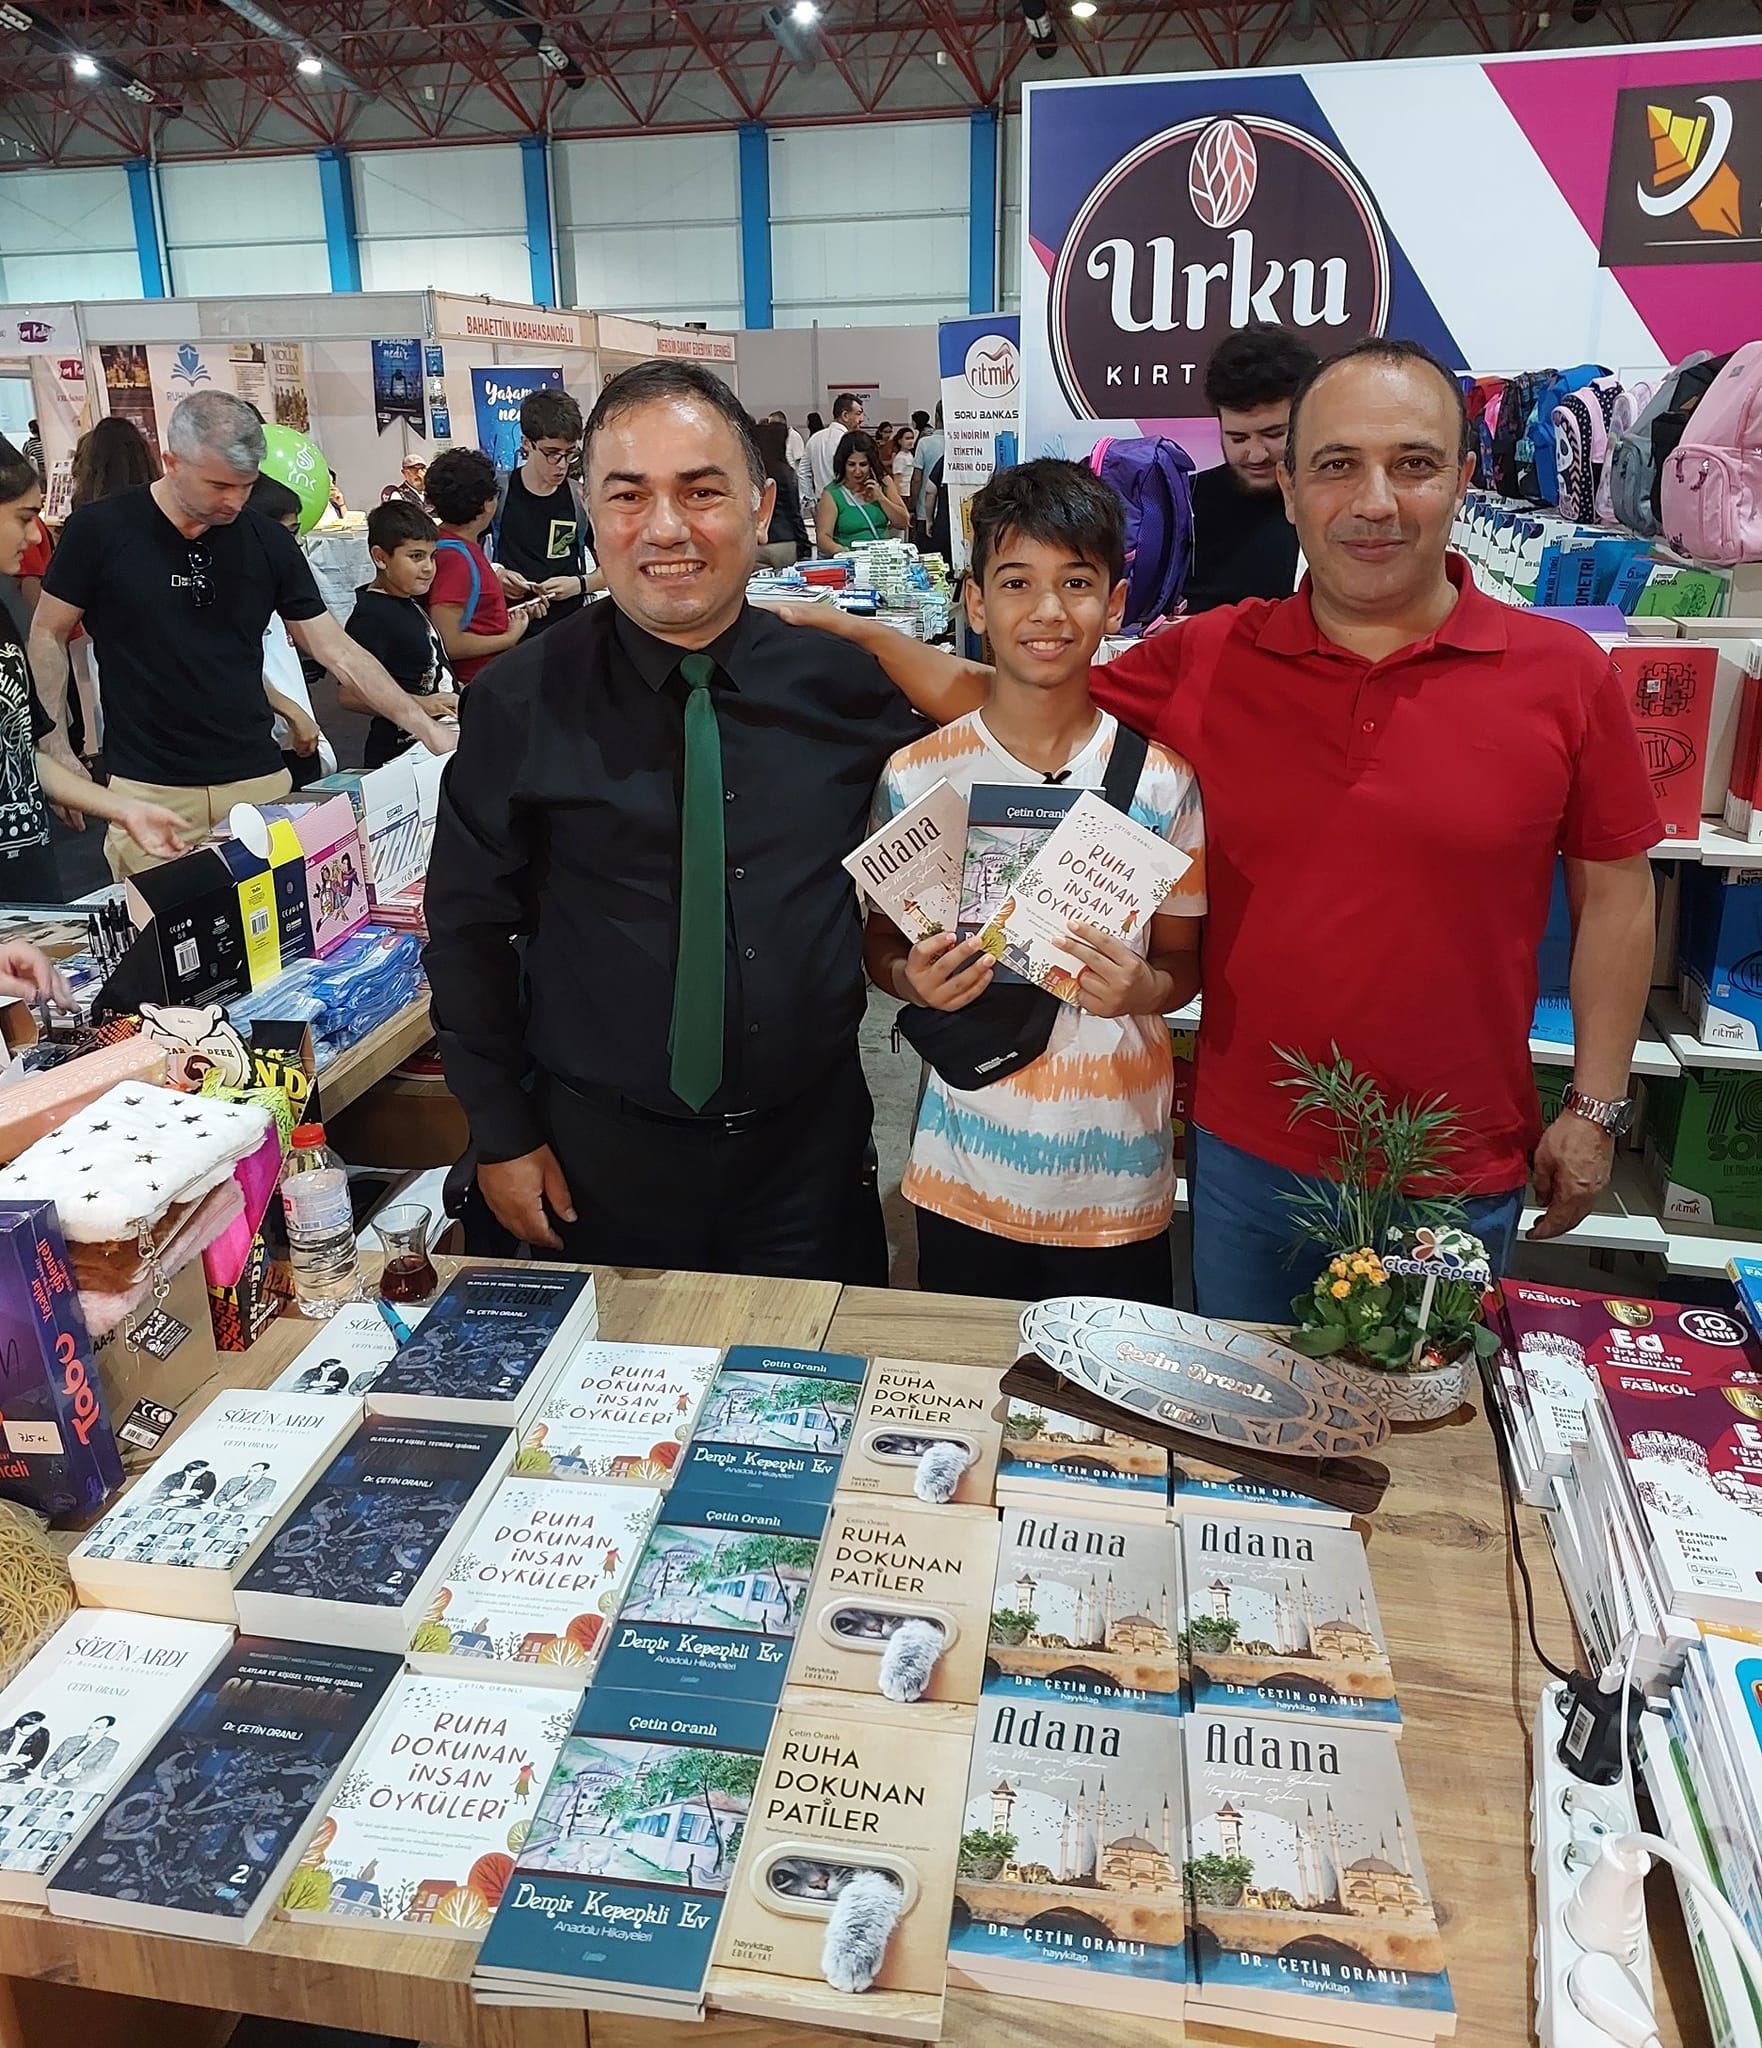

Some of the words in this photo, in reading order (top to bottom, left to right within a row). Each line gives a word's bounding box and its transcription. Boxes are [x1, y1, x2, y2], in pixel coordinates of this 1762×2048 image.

[1086, 229, 1350, 332] Urku
[467, 316, 511, 337] BAHAETTİN
[513, 322, 573, 343] KABAHASANOĞLU
[972, 358, 1015, 386] ritmik
[980, 410, 1019, 419] BANKAS
[976, 463, 992, 471] ÖDE
[1007, 808, 1033, 819] Çetin
[862, 817, 941, 886] Adana
[1089, 844, 1135, 881] RUHA
[1058, 850, 1139, 907] DOKUNAN
[1064, 879, 1113, 916] İNSAN
[1712, 1026, 1743, 1040] ritmik
[208, 1048, 235, 1058] DEER
[1670, 1204, 1700, 1214] ritmik
[36, 1238, 65, 1295] eğlenceli
[32, 1279, 53, 1323] Yasaklar
[1519, 1291, 1581, 1307] FASİKÜL
[1693, 1315, 1734, 1332] 10.
[1608, 1328, 1665, 1353] Ed
[1695, 1329, 1739, 1341] SINIF
[609, 1364, 668, 1380] RUHA
[762, 1359, 791, 1371] Çetin
[793, 1361, 828, 1373] Oranlı
[55, 1332, 100, 1446] Tabu
[581, 1376, 684, 1395] DOKUNAN
[879, 1374, 935, 1391] RUHA
[1620, 1378, 1697, 1396] FASİKÜL
[596, 1392, 659, 1408] İNSAN
[875, 1388, 984, 1410] DOKUNAN
[218, 1409, 280, 1425] SÖZÜN
[278, 1414, 325, 1428] ARDI
[569, 1403, 674, 1426] ÖYKÜLERİ
[870, 1404, 952, 1424] PATİLER
[693, 1447, 737, 1471] Demir
[743, 1451, 805, 1479] Kepenkli
[811, 1459, 834, 1474] Ev
[724, 1466, 757, 1477] Anadolu
[1026, 1460, 1045, 1471] DR.
[1051, 1463, 1088, 1476] ÇETİN
[1093, 1468, 1139, 1482] ORANLI
[363, 1475, 375, 1483] Dr.
[376, 1476, 401, 1485] ÇETİN
[400, 1478, 434, 1488] ORANLI
[1202, 1481, 1222, 1490] DR.
[1228, 1483, 1267, 1497] ÇETİN
[1272, 1488, 1308, 1501] ORAN
[529, 1510, 596, 1529] RUHA
[706, 1509, 739, 1523] Çetin
[742, 1513, 781, 1527] Oranlı
[493, 1525, 613, 1550] DOKUNAN
[841, 1526, 907, 1548] RUHA
[1016, 1518, 1126, 1558] Adana
[1201, 1523, 1315, 1562] Adana
[511, 1547, 584, 1568] İNSAN
[835, 1549, 963, 1575] DOKUNAN
[477, 1562, 599, 1590] ÖYKÜLERİ
[830, 1567, 925, 1594] PATİLER
[67, 1636, 139, 1662] SÖZÜN
[133, 1648, 190, 1667] ARDI
[618, 1629, 669, 1655] Demir
[676, 1634, 750, 1663] Kepenkli
[758, 1642, 784, 1663] Ev
[654, 1654, 693, 1668] Anadolu
[238, 1666, 267, 1675] OLAYLAR
[268, 1669, 276, 1677] VE
[278, 1670, 302, 1681] KİŞİSEL
[304, 1674, 333, 1684] TECRÜBE
[1015, 1675, 1038, 1688] DR.
[1044, 1679, 1088, 1693] ÇETİN
[1093, 1683, 1147, 1701] ORANLI
[1226, 1683, 1250, 1697] DR.
[1257, 1687, 1301, 1702] ÇETİN
[1308, 1692, 1365, 1708] ORANLI
[1275, 1701, 1317, 1713] hayykitap
[222, 1722, 235, 1731] Dr.
[237, 1723, 266, 1736] ÇETİN
[266, 1727, 304, 1741] ORANLI
[433, 1711, 509, 1737] RUHA
[629, 1715, 668, 1732] Çetin
[671, 1721, 718, 1737] Oranlı
[788, 1729, 812, 1740] Çetin
[813, 1731, 840, 1741] Oranlı
[990, 1706, 1120, 1757] Adana
[390, 1733, 528, 1764] DOKUNAN
[782, 1742, 860, 1769] RUHA
[1205, 1723, 1341, 1775] Adana
[408, 1763, 493, 1788] İNSAN
[774, 1770, 926, 1807] DOKUNAN
[368, 1784, 510, 1823] ÖYKÜLERİ
[767, 1798, 880, 1833] PATİLER
[511, 1883, 574, 1918] Demir
[583, 1890, 671, 1929] Kepenkli
[677, 1902, 712, 1930] Ev
[554, 1920, 601, 1937] Anadolu
[601, 1926, 652, 1942] Hikayeleri
[988, 1922, 1015, 1939] DR.
[1023, 1927, 1074, 1947] ÇETİN
[1081, 1935, 1146, 1958] ORANLI
[732, 1938, 775, 1953] hayykitap
[1042, 1946, 1089, 1964] hayykitap
[1240, 1951, 1270, 1968] DR.
[1278, 1956, 1333, 1977] ÇETİN
[1340, 1965, 1409, 1987] ORANLI
[1301, 1977, 1351, 1995] hayykitap
